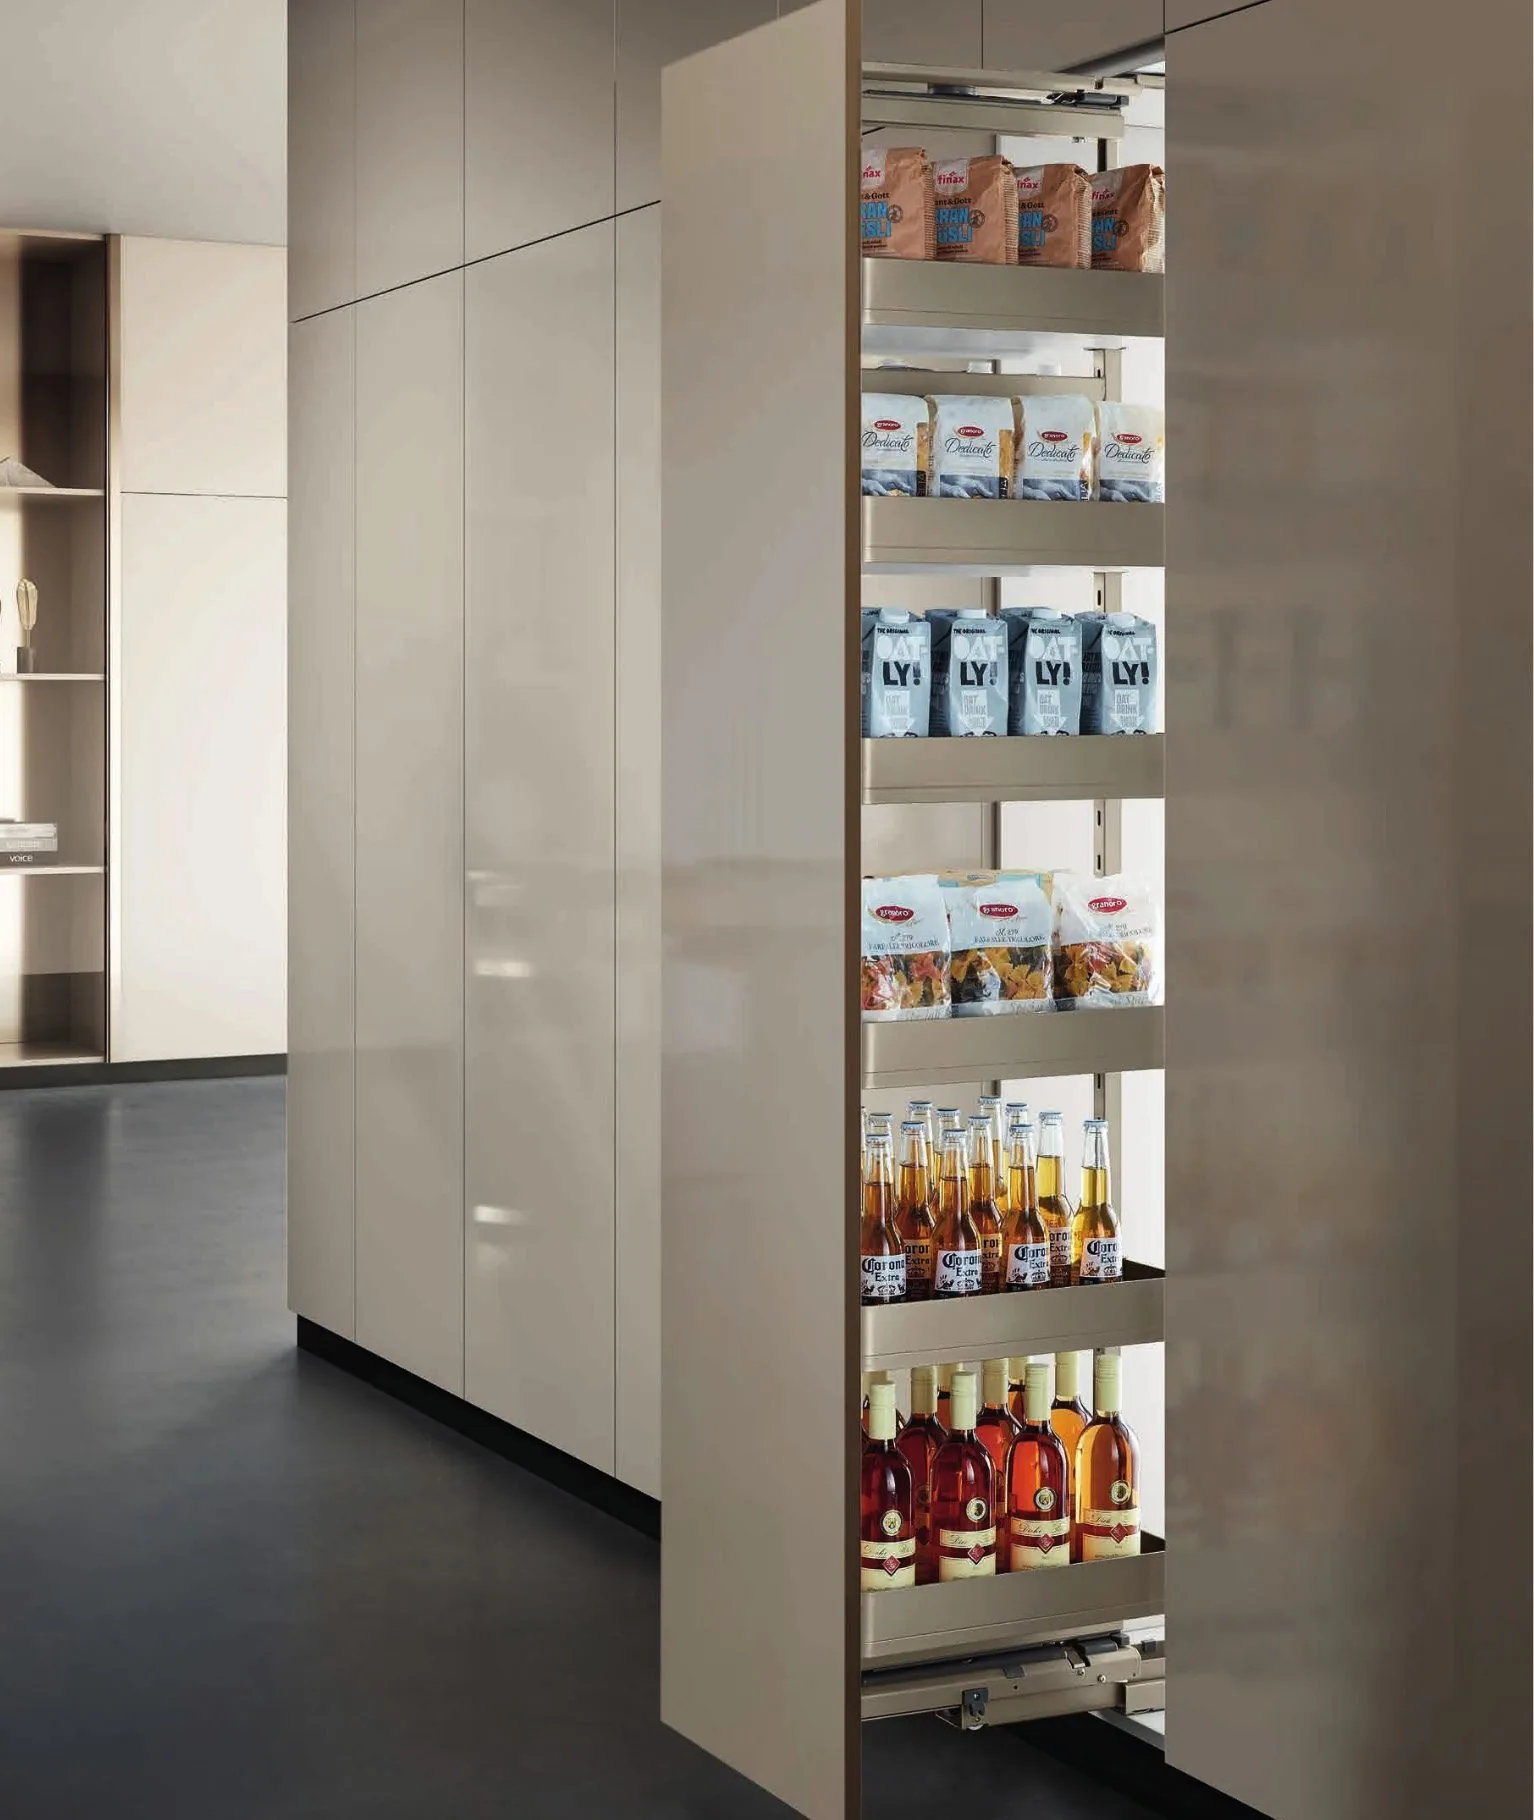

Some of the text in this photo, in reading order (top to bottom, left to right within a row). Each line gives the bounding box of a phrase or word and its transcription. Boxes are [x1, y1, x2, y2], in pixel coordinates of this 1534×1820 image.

[937, 173, 965, 184] finax
[1017, 179, 1038, 189] inax
[862, 431, 914, 452] Dedicato
[944, 438, 997, 458] Dedicato
[1029, 441, 1080, 462] Dedicato
[1105, 443, 1155, 464] Dedicato
[877, 636, 926, 660] OAT
[954, 636, 1003, 660] OAT
[1028, 636, 1077, 660] OAT
[1102, 636, 1152, 660] OAT
[882, 661, 921, 686] LY!
[960, 661, 998, 686] LY!
[1036, 661, 1071, 685] LY!
[1112, 661, 1150, 685] LY!
[1092, 901, 1122, 909] granoro
[1014, 1245, 1046, 1262] Coro
[1087, 1240, 1118, 1256] Coro
[906, 1255, 929, 1264] Extra
[875, 1272, 899, 1281] Extra
